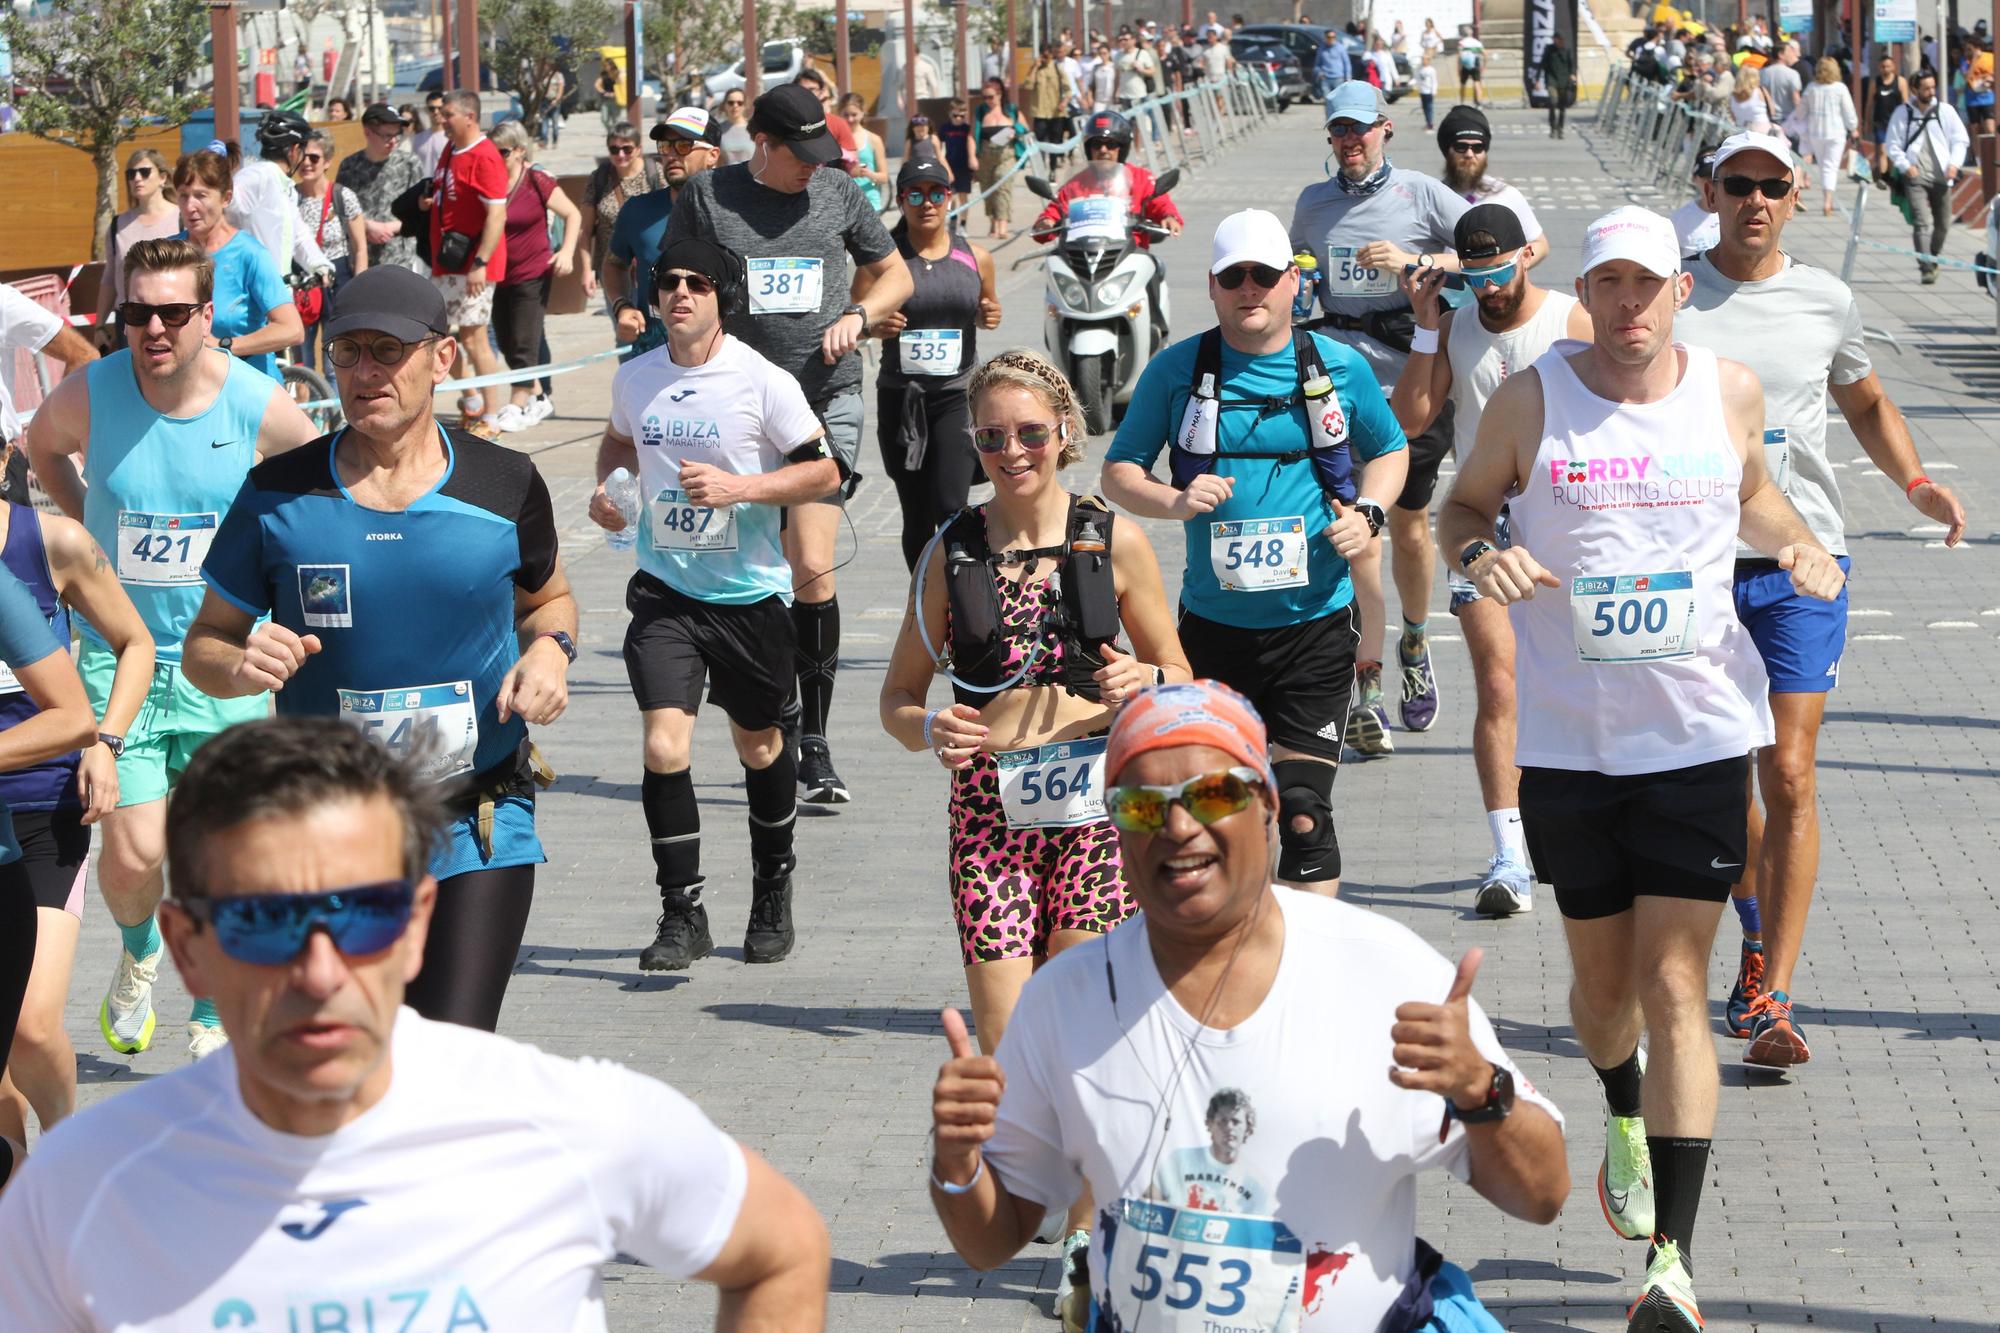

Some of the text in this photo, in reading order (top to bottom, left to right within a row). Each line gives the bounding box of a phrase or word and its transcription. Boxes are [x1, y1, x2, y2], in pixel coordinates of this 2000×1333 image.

[760, 273, 804, 295] 381
[910, 343, 947, 361] 535
[1191, 409, 1202, 428] MAX
[667, 420, 720, 439] IBIZA
[666, 438, 720, 449] MARATHON
[1552, 478, 1724, 506] RUNNING CLUB
[1591, 502, 1610, 511] night
[1632, 500, 1655, 509] young,
[664, 507, 714, 533] 487
[365, 533, 403, 541] ATORKA
[132, 534, 191, 563] 421
[1225, 539, 1285, 570] 548
[1273, 568, 1291, 576] Davi
[1585, 581, 1609, 590] IBIZA
[1591, 598, 1668, 637] 500
[1665, 635, 1680, 646] JUT
[1316, 730, 1339, 742] adidas
[1020, 762, 1092, 805] 564
[1084, 798, 1105, 808] Lucy
[1184, 1173, 1252, 1200] MARATHON
[1130, 1244, 1252, 1317] 553
[287, 1283, 490, 1333] IBIZA
